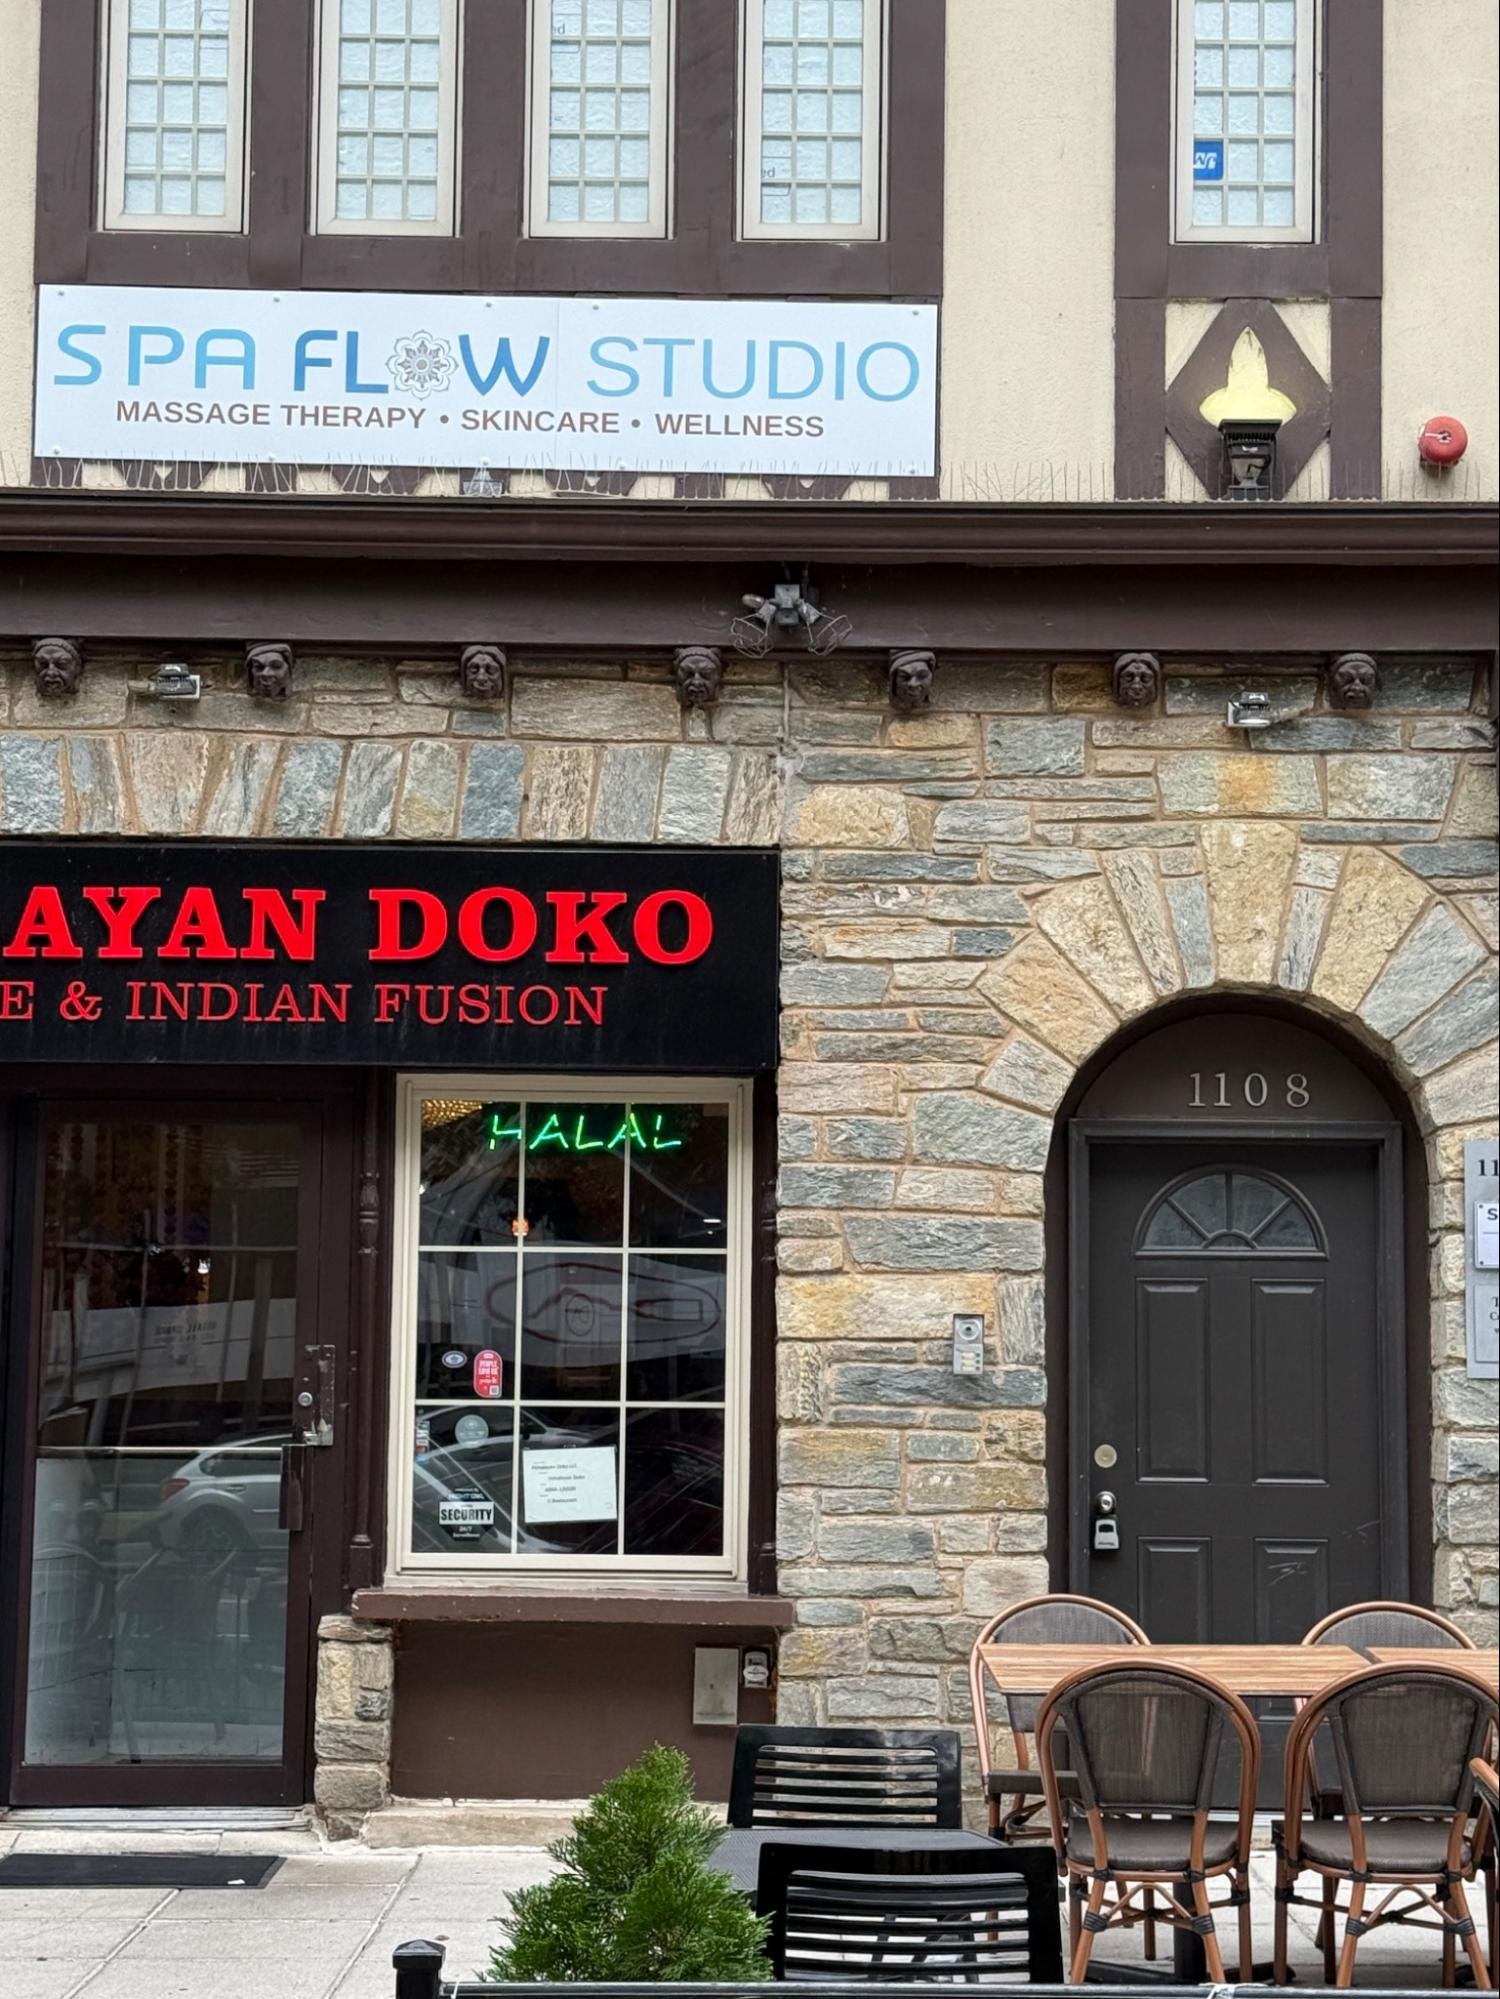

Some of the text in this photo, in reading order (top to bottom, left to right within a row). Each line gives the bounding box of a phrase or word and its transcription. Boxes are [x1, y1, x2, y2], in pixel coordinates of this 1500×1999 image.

[53, 324, 257, 391] SPA
[586, 336, 921, 403] STUDIO
[116, 400, 824, 437] MASSAGE THERAPY SKINCARE WELLNESS
[3, 885, 714, 965] AYAN DOKO
[0, 981, 608, 1025] E & INDIAN FUSION
[1187, 1072, 1312, 1109] 1108
[489, 1113, 682, 1151] HALAL
[440, 1508, 492, 1521] SECURITY
